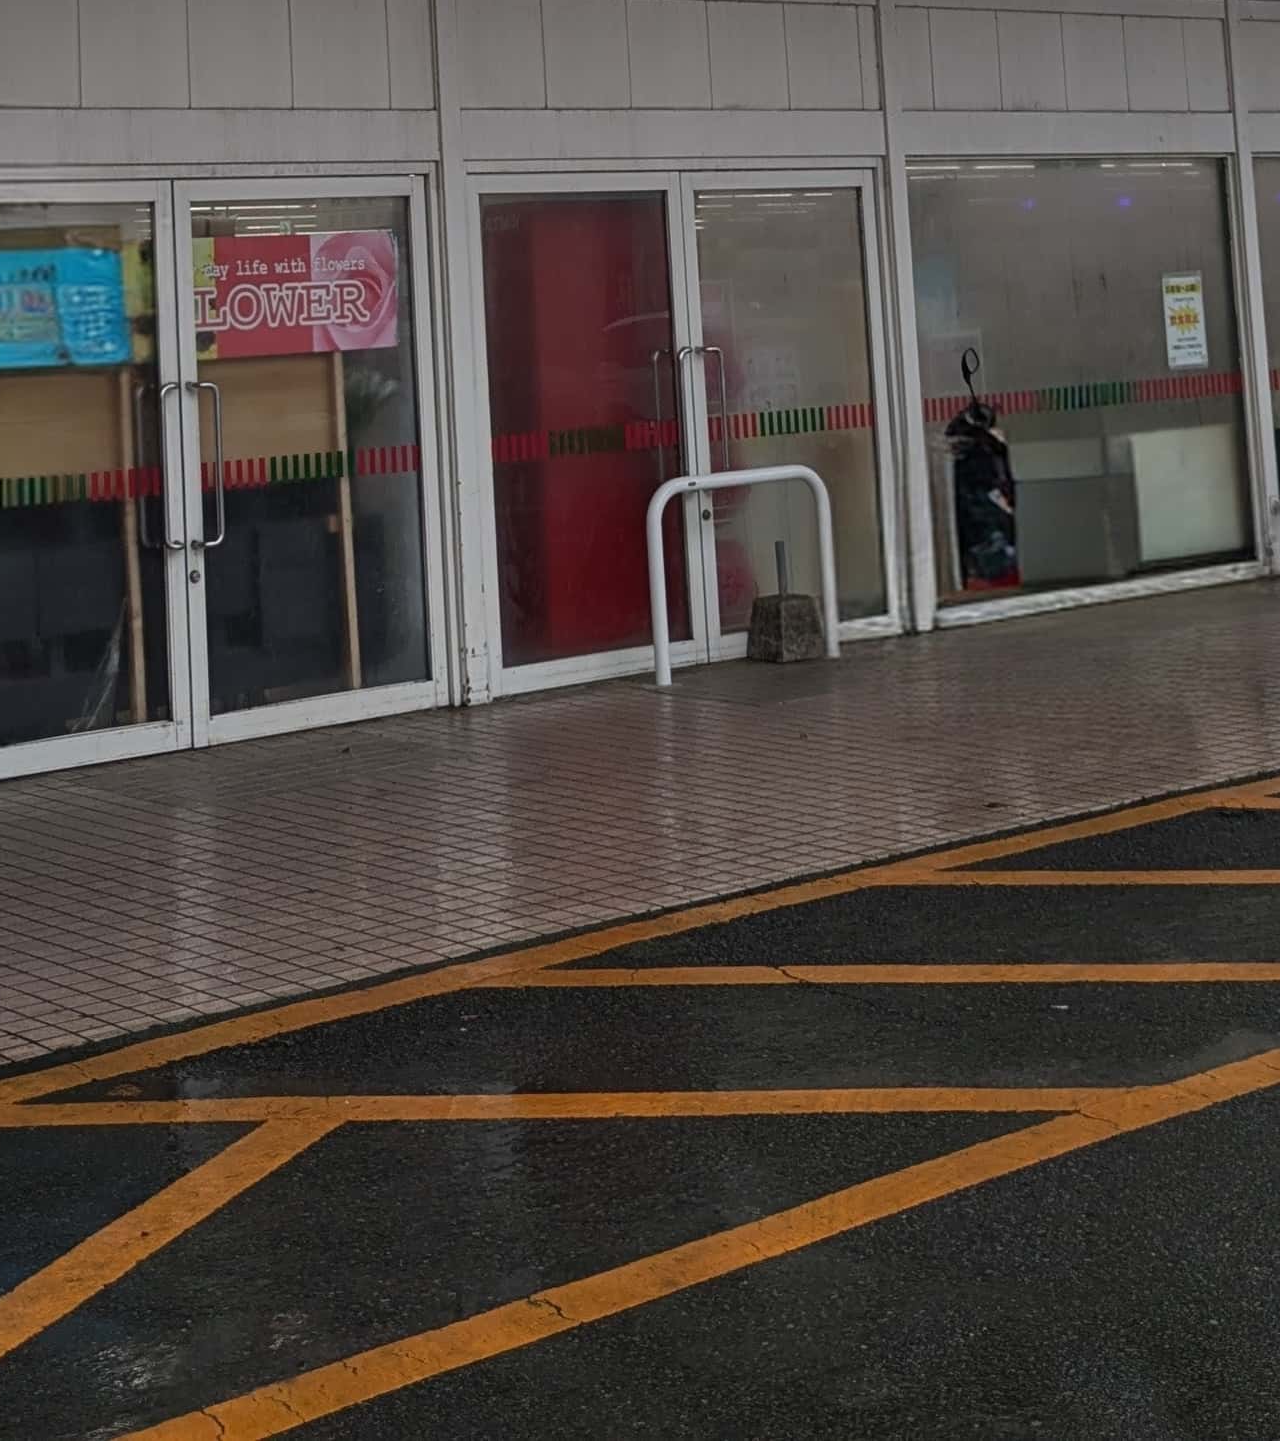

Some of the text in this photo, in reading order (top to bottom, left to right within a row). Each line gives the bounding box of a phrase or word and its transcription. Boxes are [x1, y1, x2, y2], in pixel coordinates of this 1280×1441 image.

[237, 260, 268, 276] life
[275, 259, 306, 274] with
[313, 259, 366, 272] flowers
